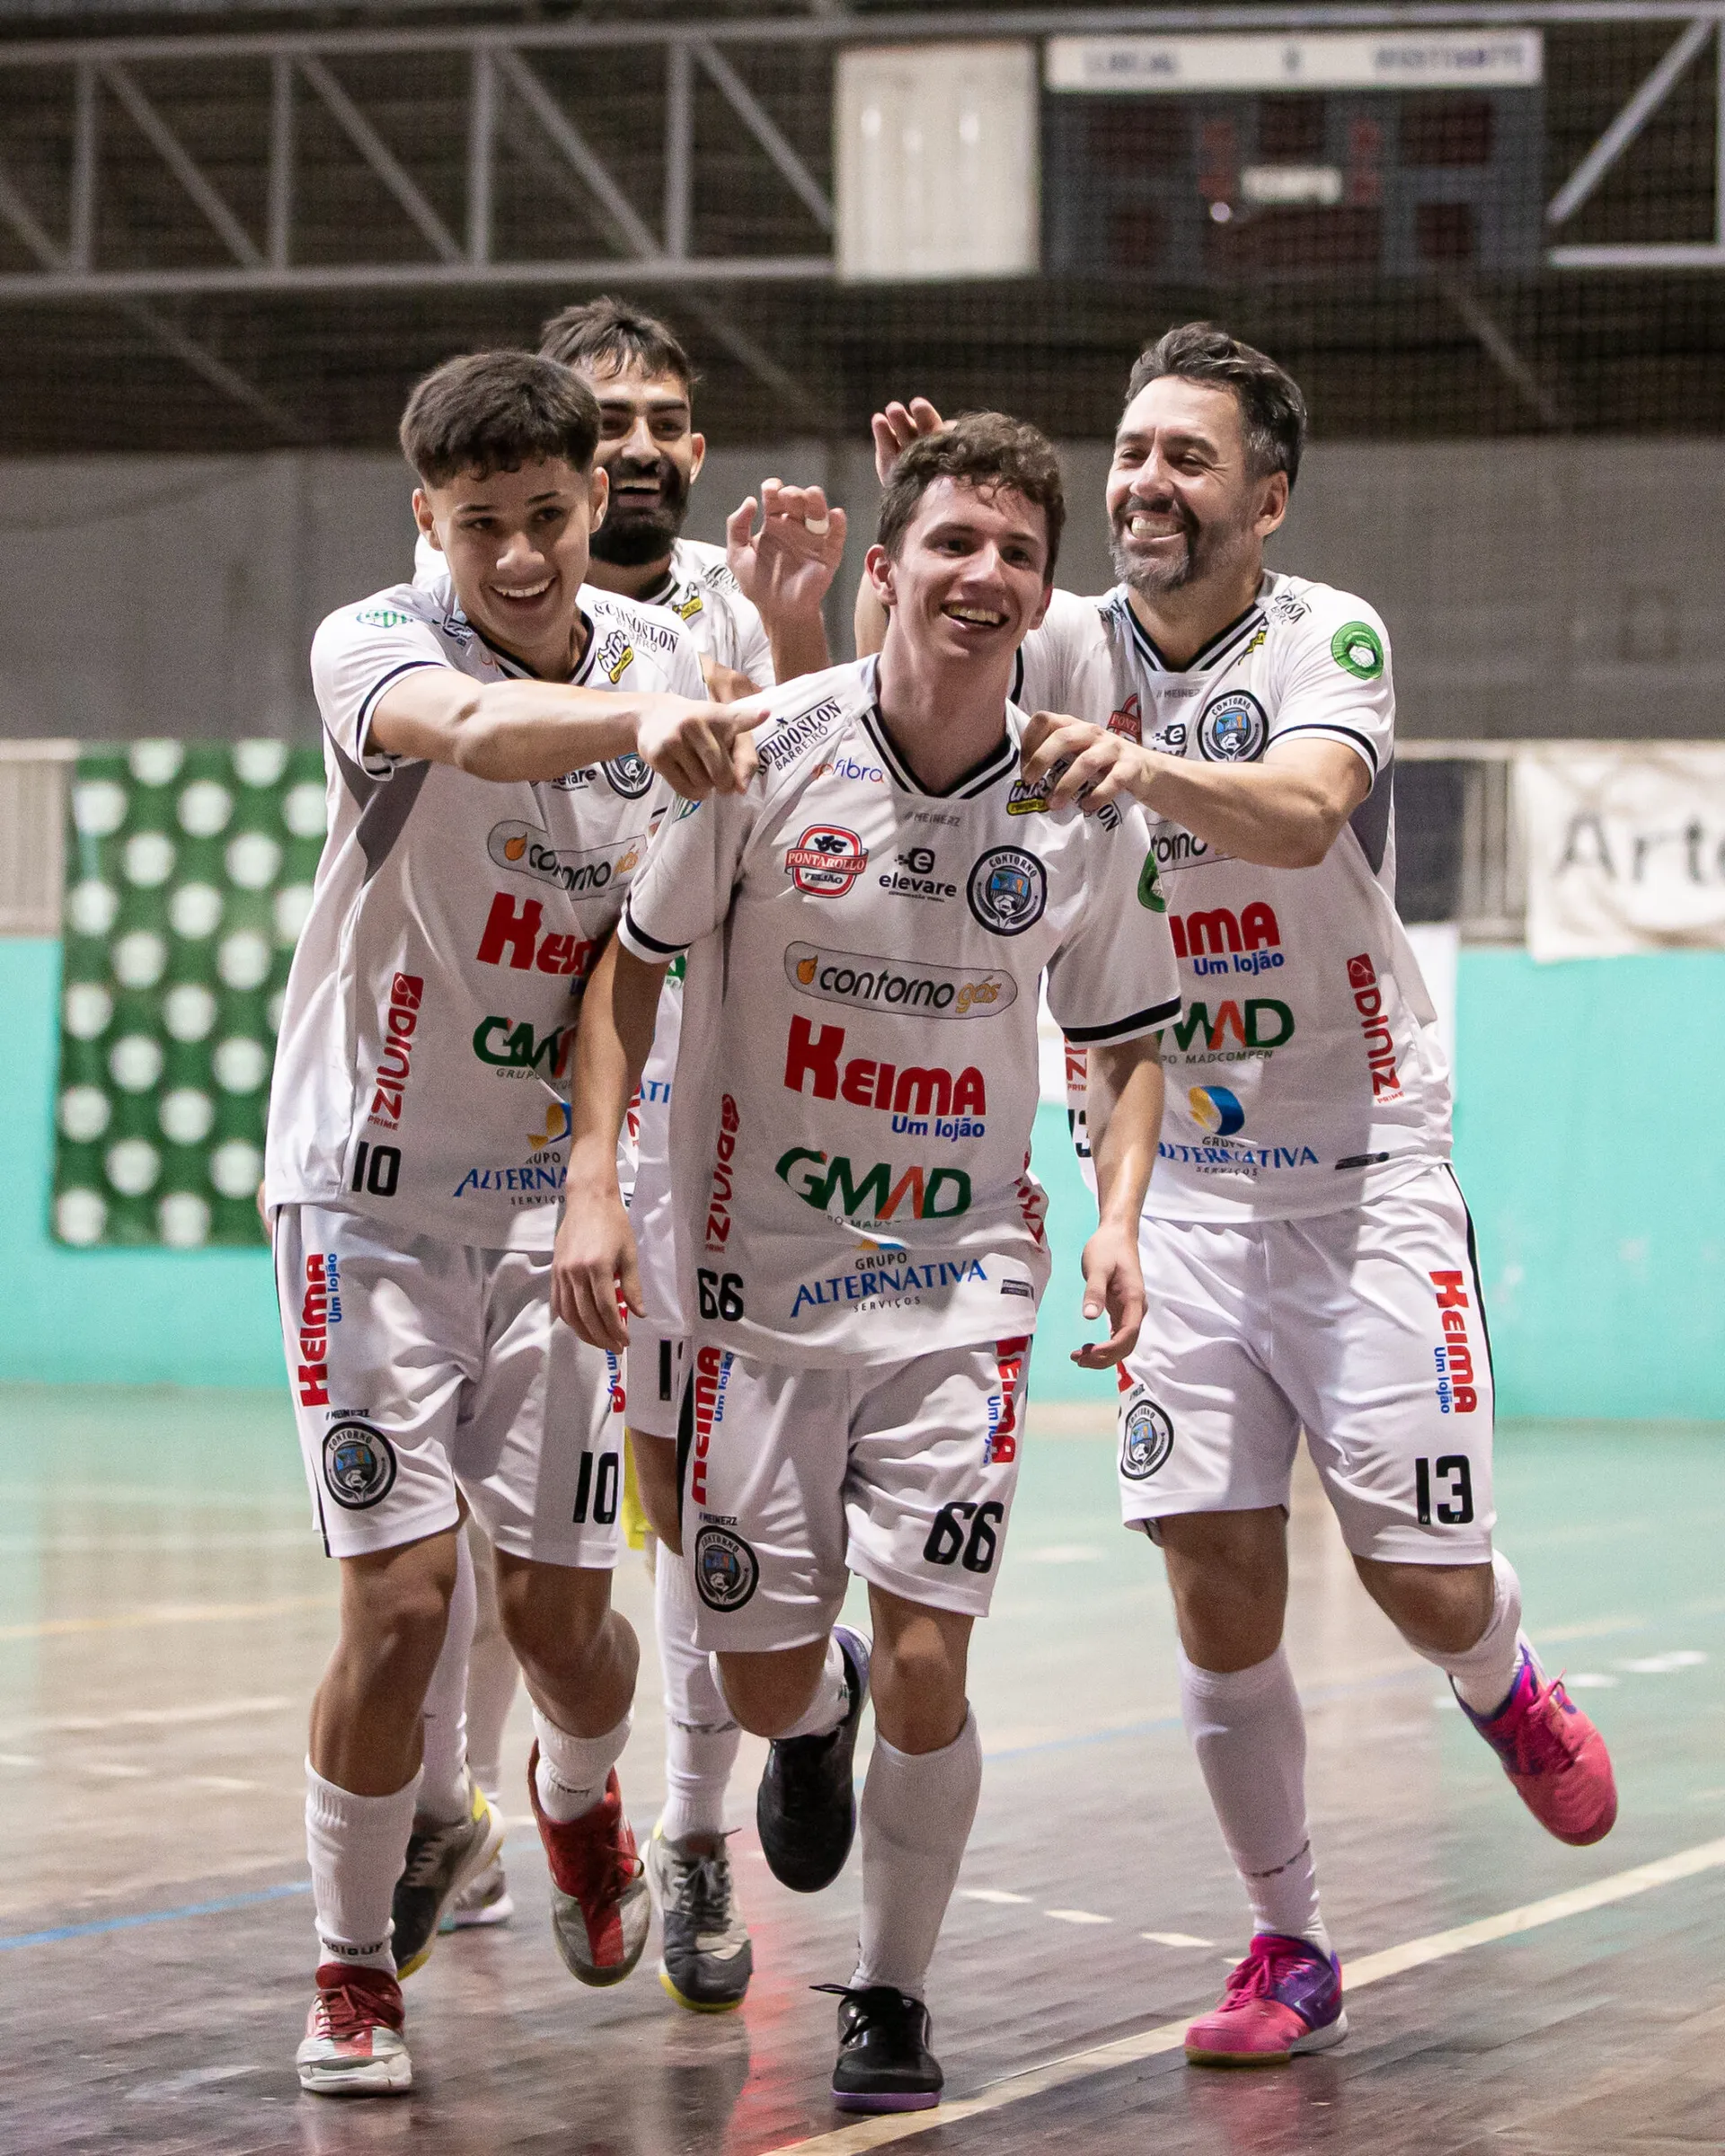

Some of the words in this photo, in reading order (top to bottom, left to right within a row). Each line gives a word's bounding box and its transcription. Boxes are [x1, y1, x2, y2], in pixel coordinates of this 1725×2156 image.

[1212, 697, 1252, 716] CONTORNO
[774, 725, 828, 772] BARBEIRO
[787, 852, 866, 872] PONTAROLLO
[989, 854, 1038, 878] CONTORNO
[879, 872, 958, 897] elevare
[1169, 901, 1282, 959] IMA
[1193, 956, 1231, 976] Um
[1234, 950, 1285, 976] lojão
[819, 966, 956, 1009] contorno
[955, 975, 1003, 1013] gás
[1156, 998, 1296, 1052] MAD
[367, 1115, 400, 1132] PRIME
[891, 1116, 928, 1135] Um
[934, 1118, 986, 1143] lojão
[351, 1141, 402, 1197] 10
[774, 1146, 971, 1221] GMAD
[327, 1253, 341, 1294] lojão
[855, 1252, 907, 1270] GRUPO
[697, 1268, 745, 1322] 66
[790, 1259, 988, 1319] ALTERNATIVA
[854, 1295, 921, 1313] SERVIÇOS
[327, 1296, 342, 1324] Um
[1434, 1347, 1447, 1373] Um
[714, 1394, 725, 1423] Um
[986, 1395, 1003, 1421] Um
[1435, 1376, 1453, 1415] lojão
[572, 1450, 620, 1524] 10
[1415, 1454, 1475, 1526] 13
[923, 1500, 1004, 1574] 66
